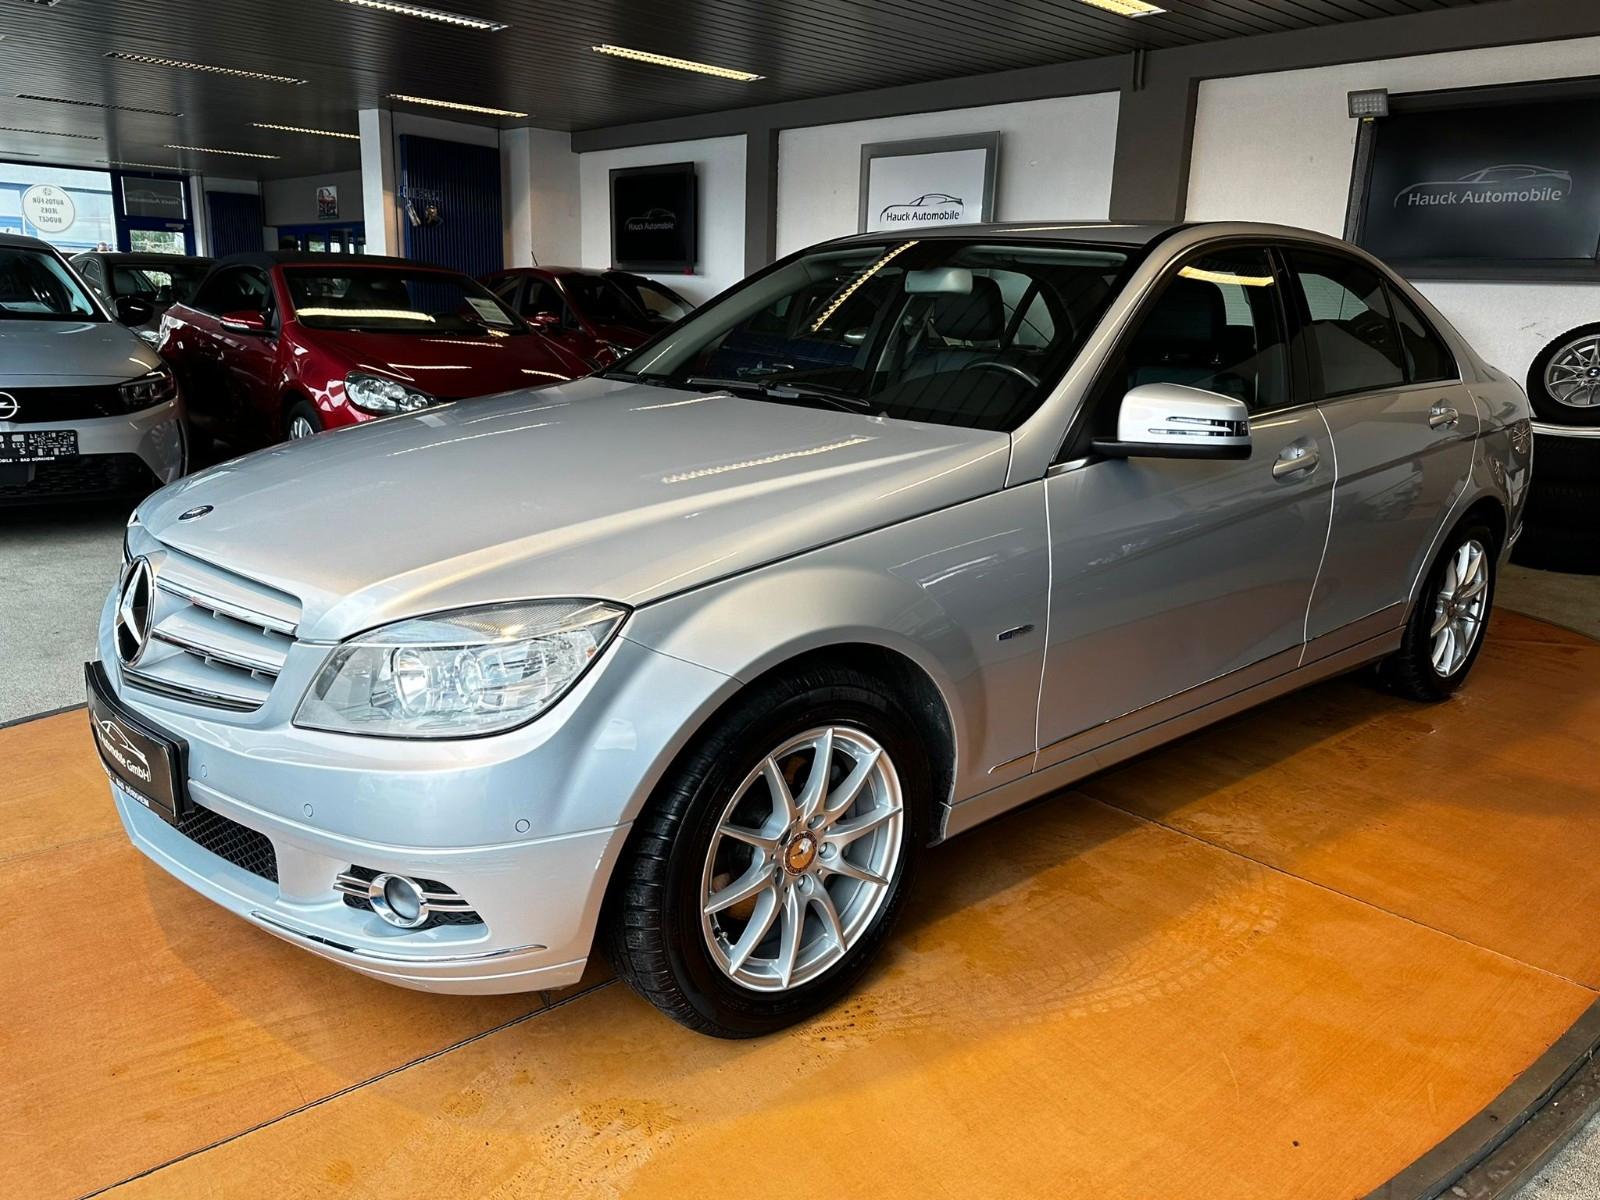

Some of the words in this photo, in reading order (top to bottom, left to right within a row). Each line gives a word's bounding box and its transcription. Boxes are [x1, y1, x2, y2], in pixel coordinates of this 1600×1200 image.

[1407, 191, 1457, 206] Hauck
[1460, 187, 1563, 204] Automobile
[886, 211, 911, 222] Hauck
[911, 210, 960, 222] Automobile
[126, 759, 149, 781] GmbH
